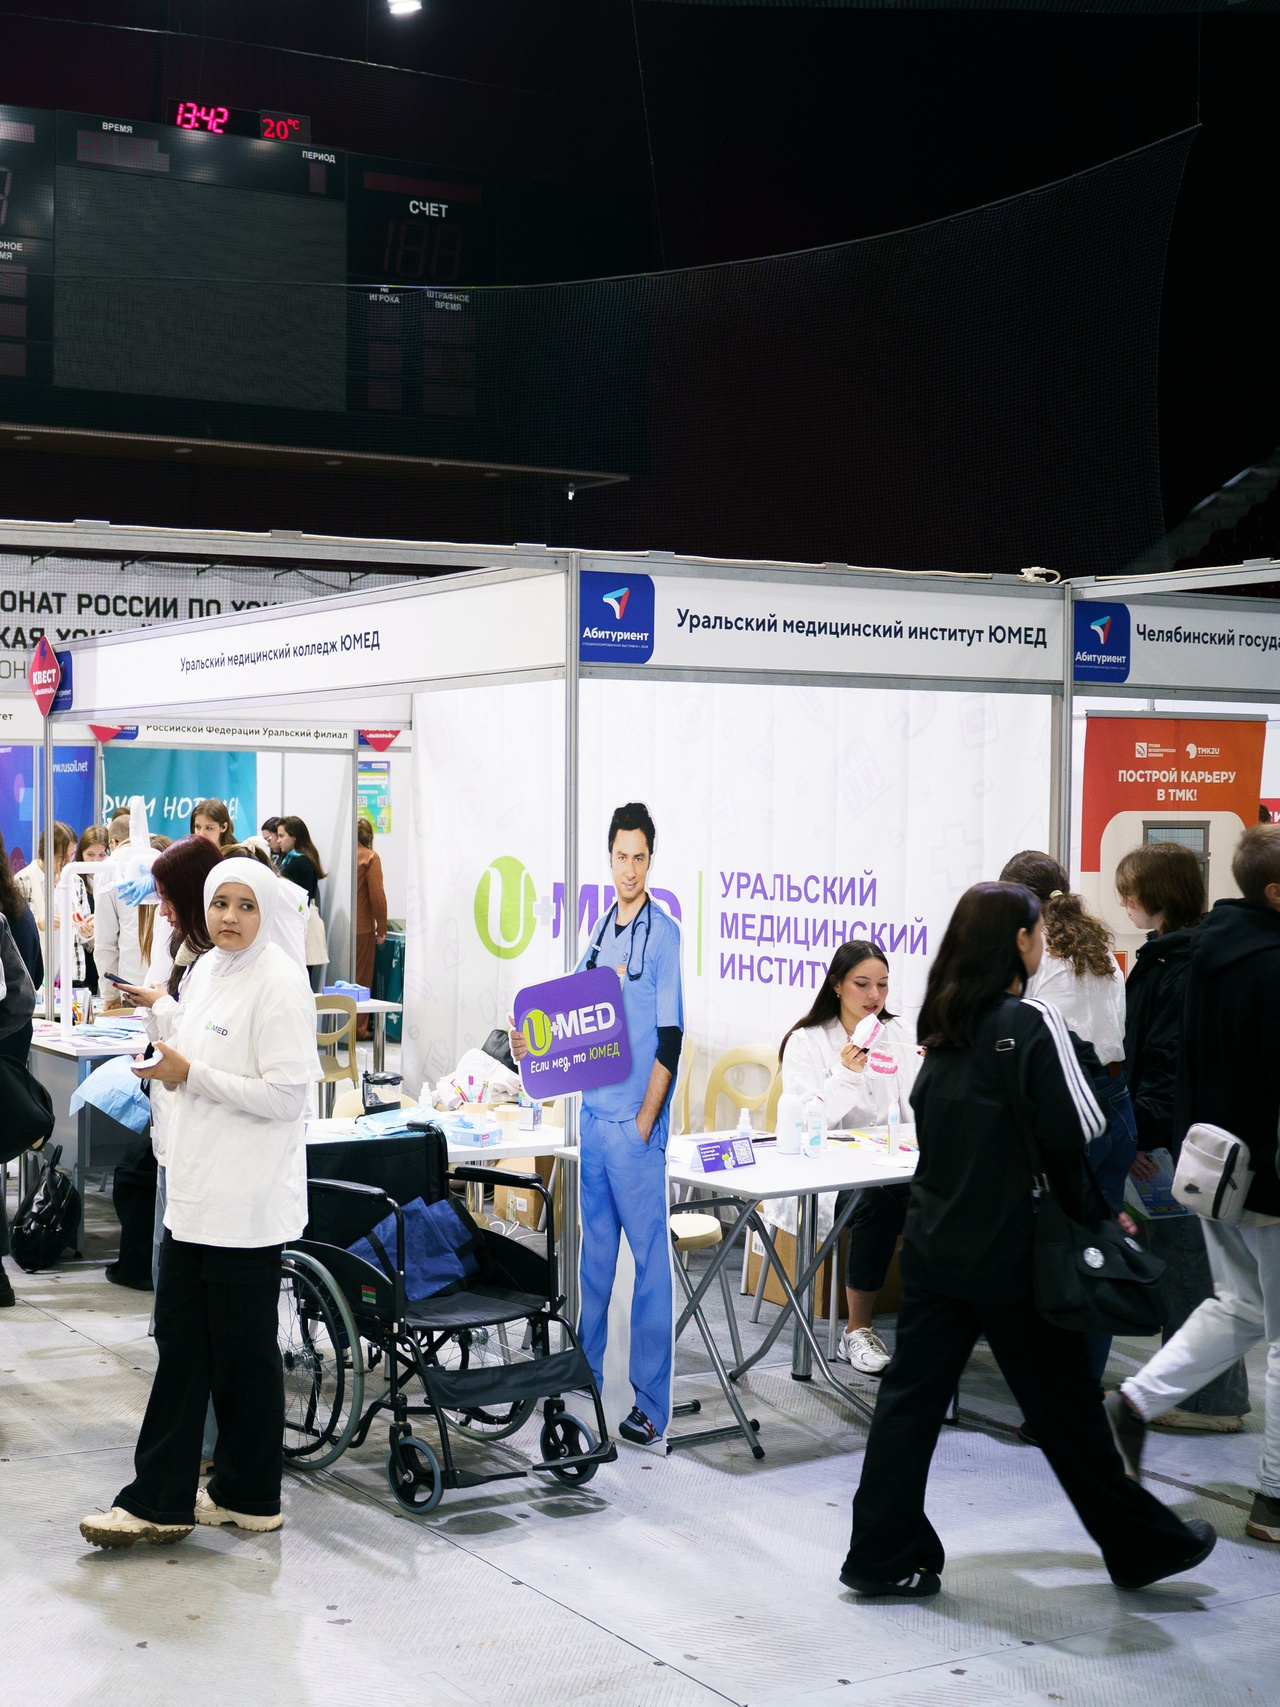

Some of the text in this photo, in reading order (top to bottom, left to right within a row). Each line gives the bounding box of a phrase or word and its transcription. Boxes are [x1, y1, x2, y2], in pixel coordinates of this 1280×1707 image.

[176, 102, 229, 134] 13:42
[102, 121, 133, 134] ВРЕМЯ
[302, 150, 336, 163] ПЕРИОД
[408, 200, 449, 218] СЧЕТ
[369, 293, 401, 304] ИГРОКА
[426, 290, 470, 302] ШТРАФНОЕ
[434, 301, 462, 311] ВРЕМЯ
[76, 593, 178, 619] РОССИИ
[188, 597, 222, 619] ПО
[582, 626, 649, 642] Абитуриент
[677, 607, 1048, 648] Уральский медицинский институт ЮМЕД
[1136, 623, 1235, 647] Челябинский
[180, 630, 381, 675] Уральский медицинский колледж ЮМЕД
[1075, 651, 1126, 665] Абитуриент
[32, 668, 57, 686] КВЕСТ
[206, 725, 260, 737] Федерации
[262, 727, 311, 738] Уральский
[313, 729, 348, 740] филиал
[1118, 767, 1236, 783] ПОСТРОЙ КАРЬЕРУ
[1157, 789, 1197, 801] В ТМК!
[720, 869, 877, 907] УРАЛЬСКИЙ
[720, 912, 928, 956] МЕДИЦИНСКИЙ
[530, 1042, 620, 1074] Если мед, то ЮМЕД
